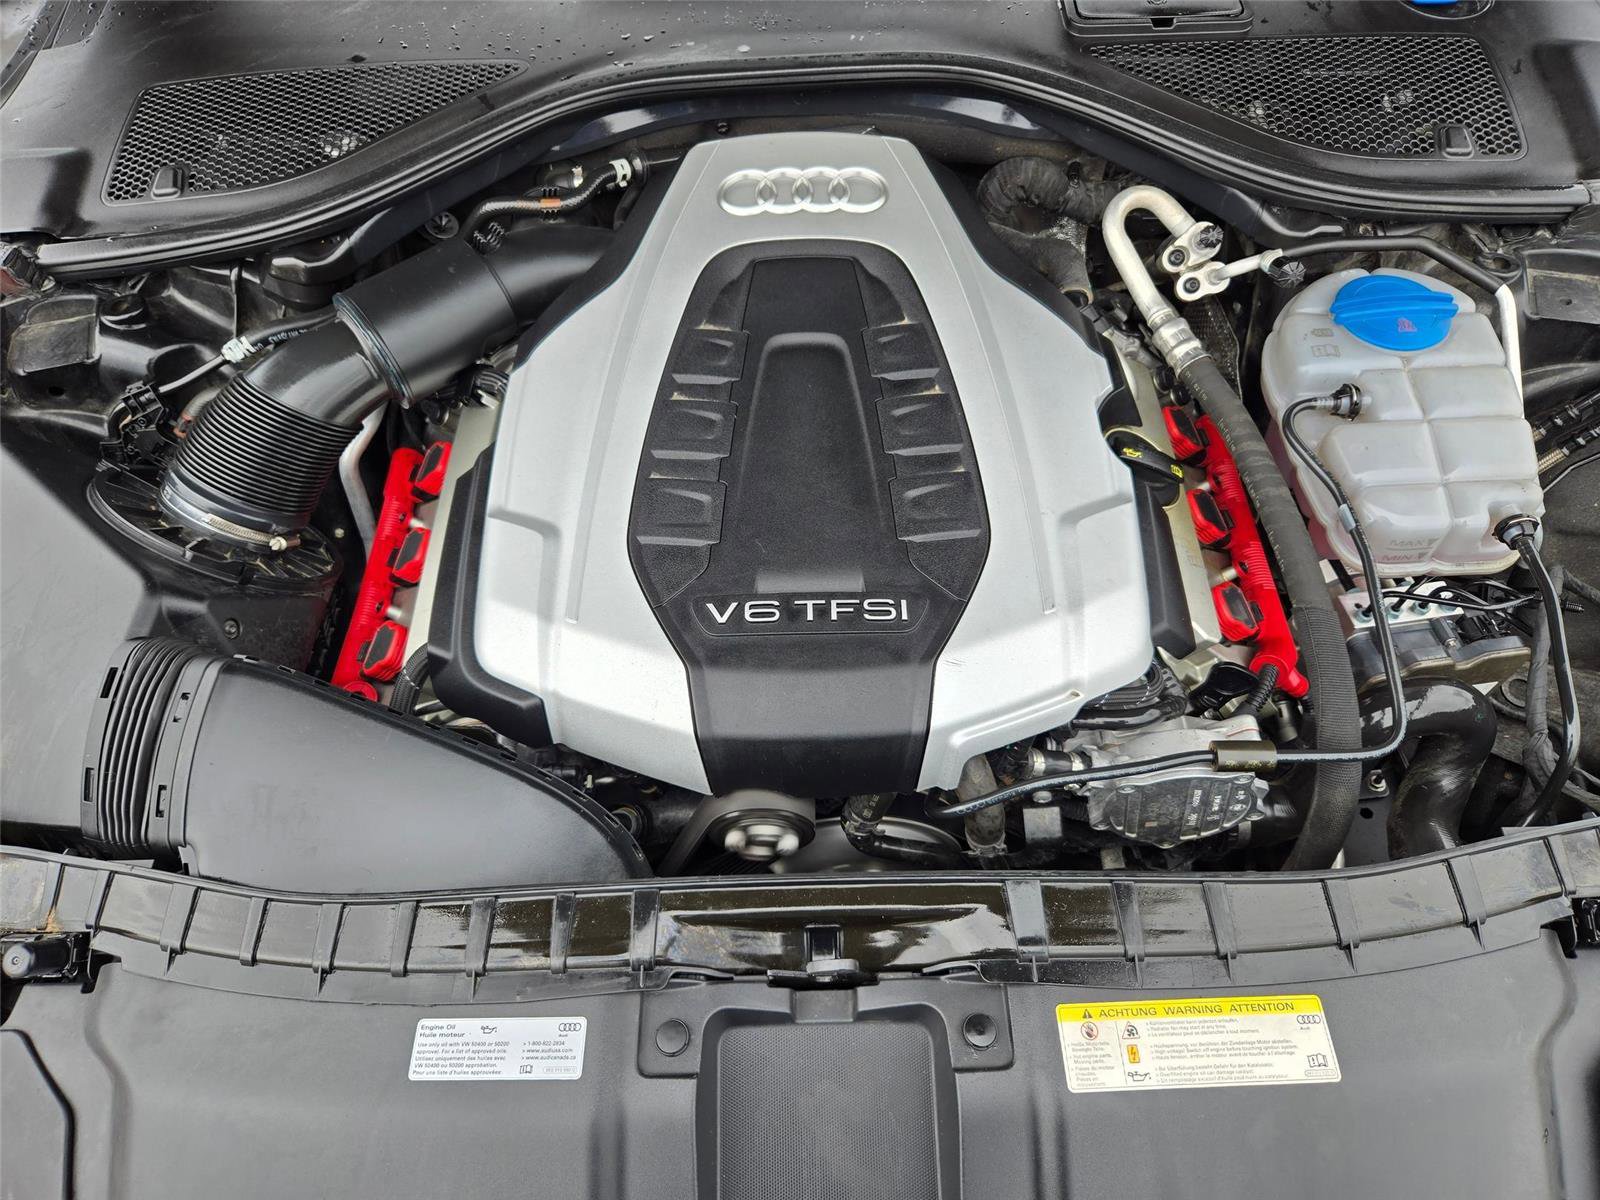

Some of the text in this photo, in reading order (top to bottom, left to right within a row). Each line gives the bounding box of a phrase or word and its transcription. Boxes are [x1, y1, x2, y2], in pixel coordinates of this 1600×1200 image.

[705, 598, 908, 624] V6 TFSI
[1099, 1002, 1295, 1018] ACHTUNG WARNING ATTENTION
